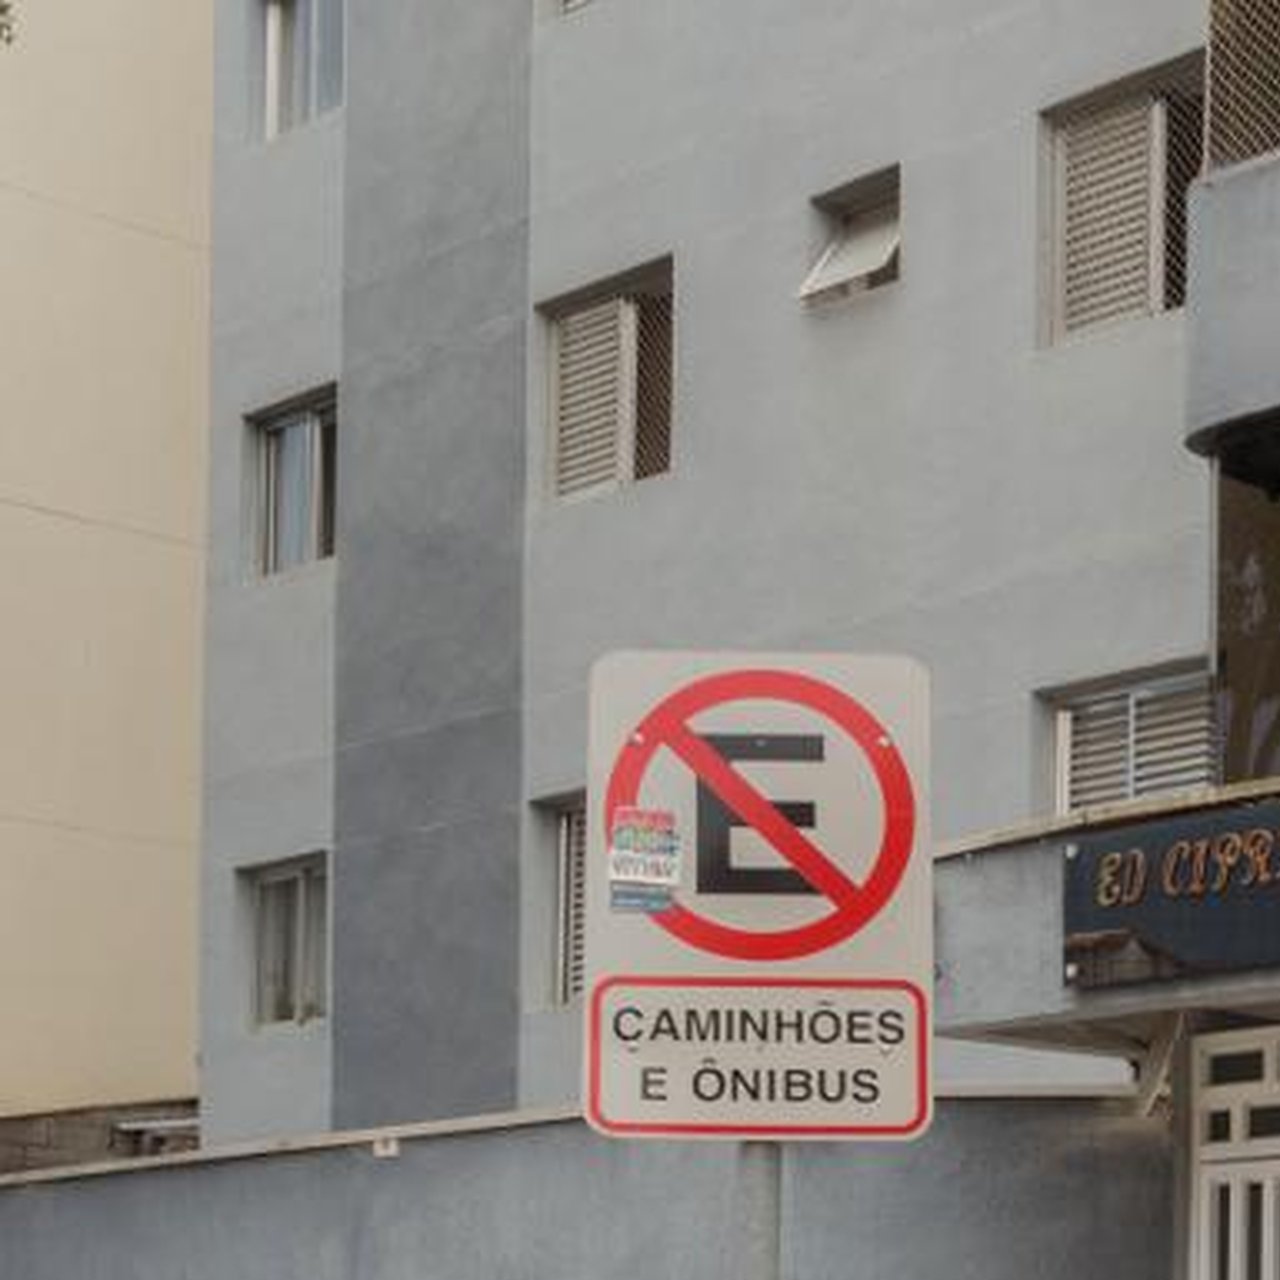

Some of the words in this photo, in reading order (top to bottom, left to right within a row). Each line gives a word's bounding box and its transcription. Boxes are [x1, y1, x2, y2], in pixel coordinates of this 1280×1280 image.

[697, 733, 824, 894] E
[1096, 847, 1146, 906] ED
[612, 1000, 905, 1045] CAMINHÕES
[641, 1068, 667, 1101] E
[692, 1058, 881, 1103] ÔNIBUS
